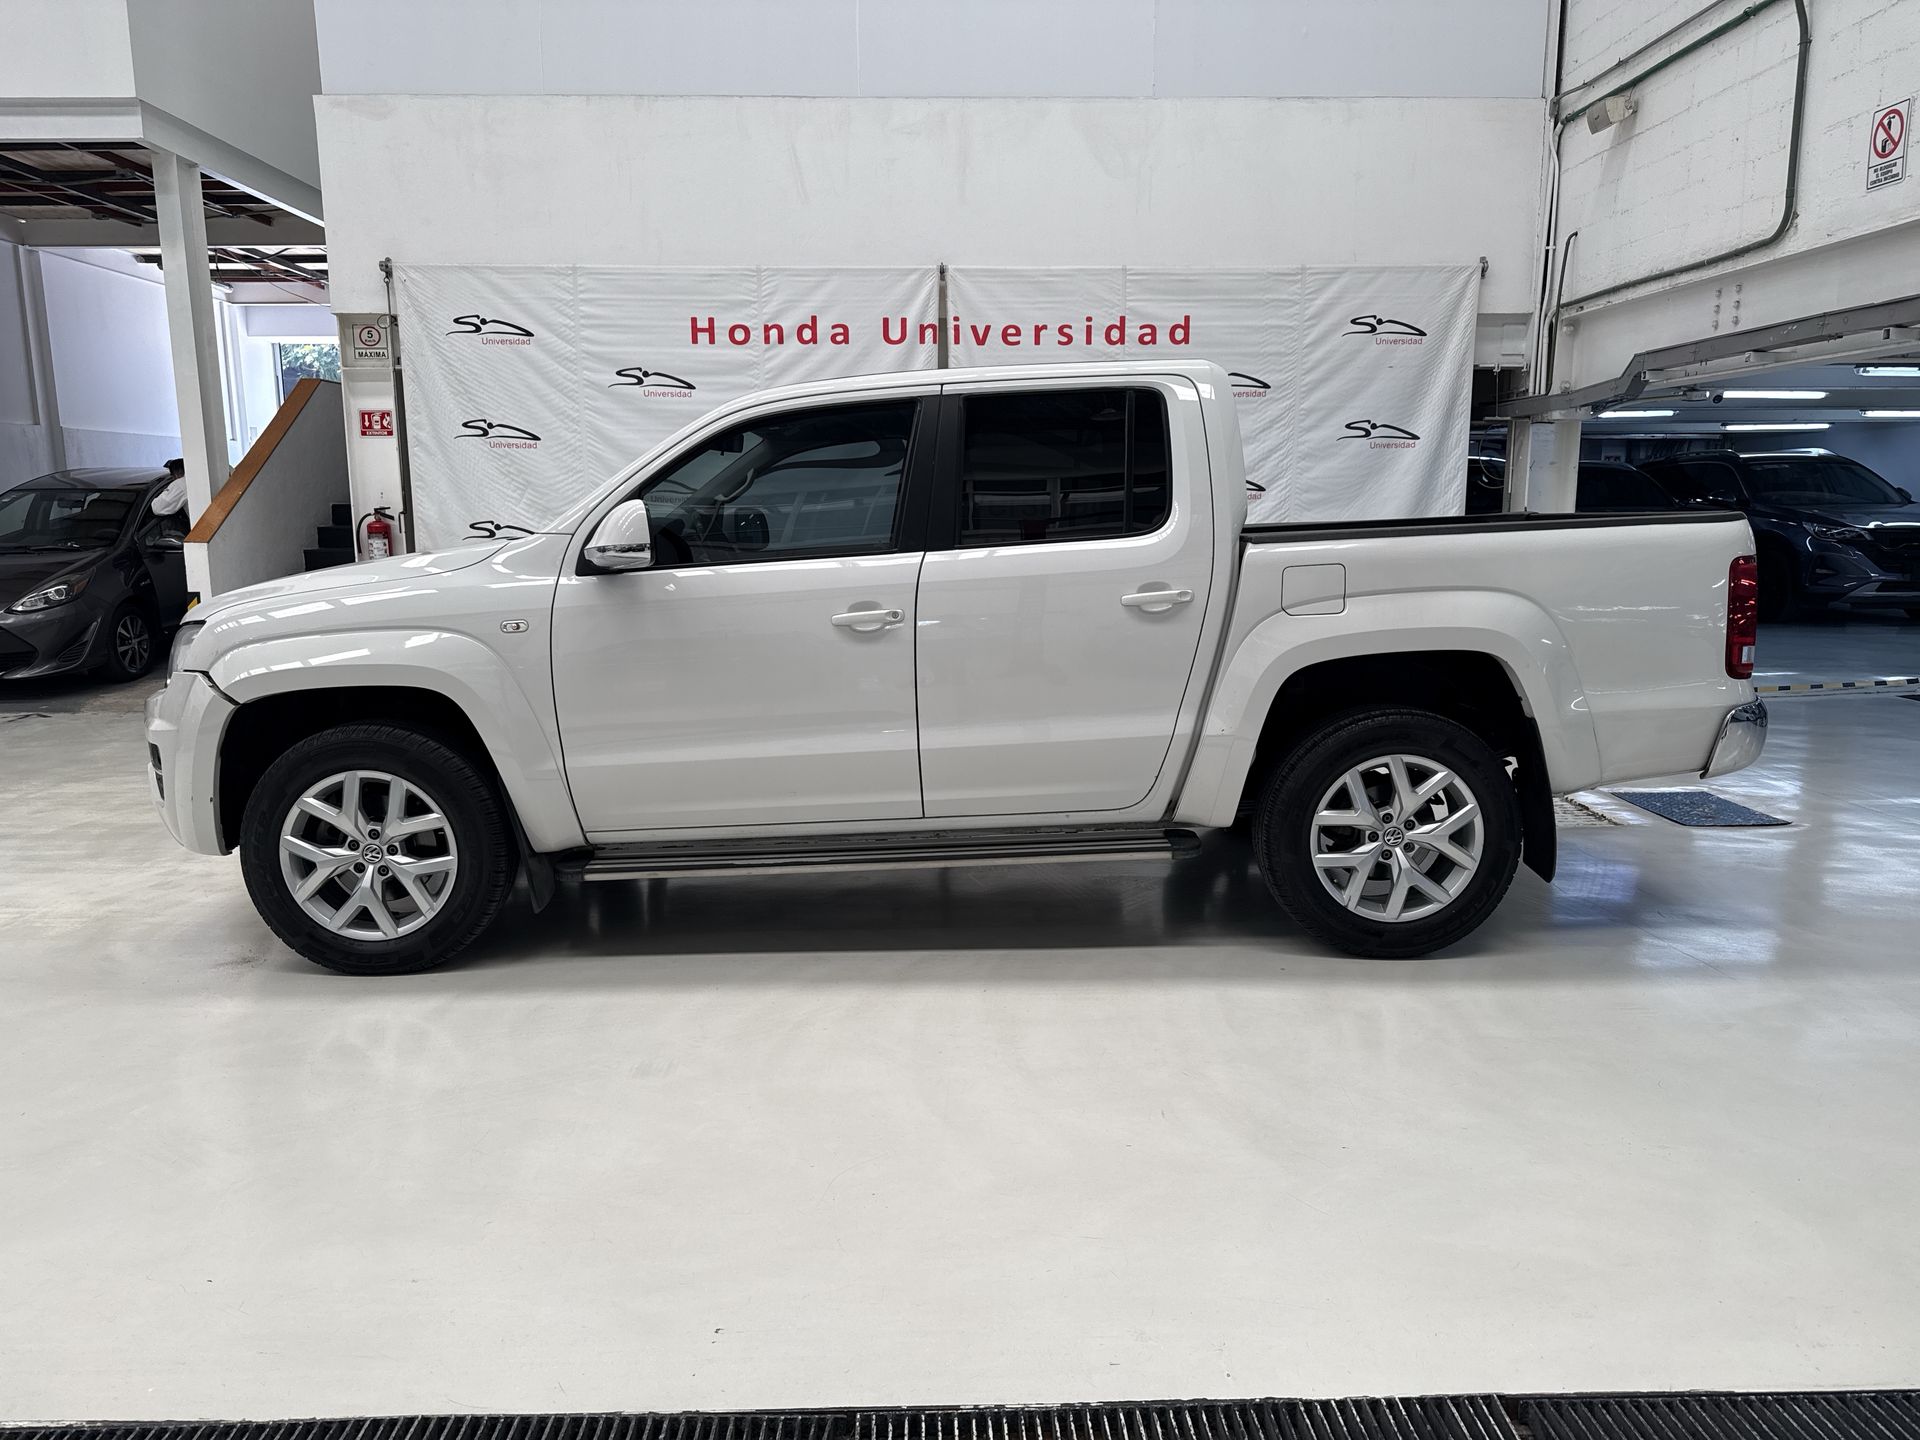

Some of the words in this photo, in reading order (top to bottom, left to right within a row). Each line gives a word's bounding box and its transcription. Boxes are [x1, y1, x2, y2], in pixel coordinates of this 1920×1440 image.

[367, 330, 374, 339] 5
[690, 315, 850, 346] Honda
[882, 315, 1191, 347] Universidad
[481, 337, 531, 346] Universidad
[1375, 337, 1423, 345] Universidad
[643, 389, 692, 398] Universidad
[1232, 390, 1267, 398] versidad
[489, 441, 538, 449] Universidad
[1369, 441, 1416, 449] Universidad
